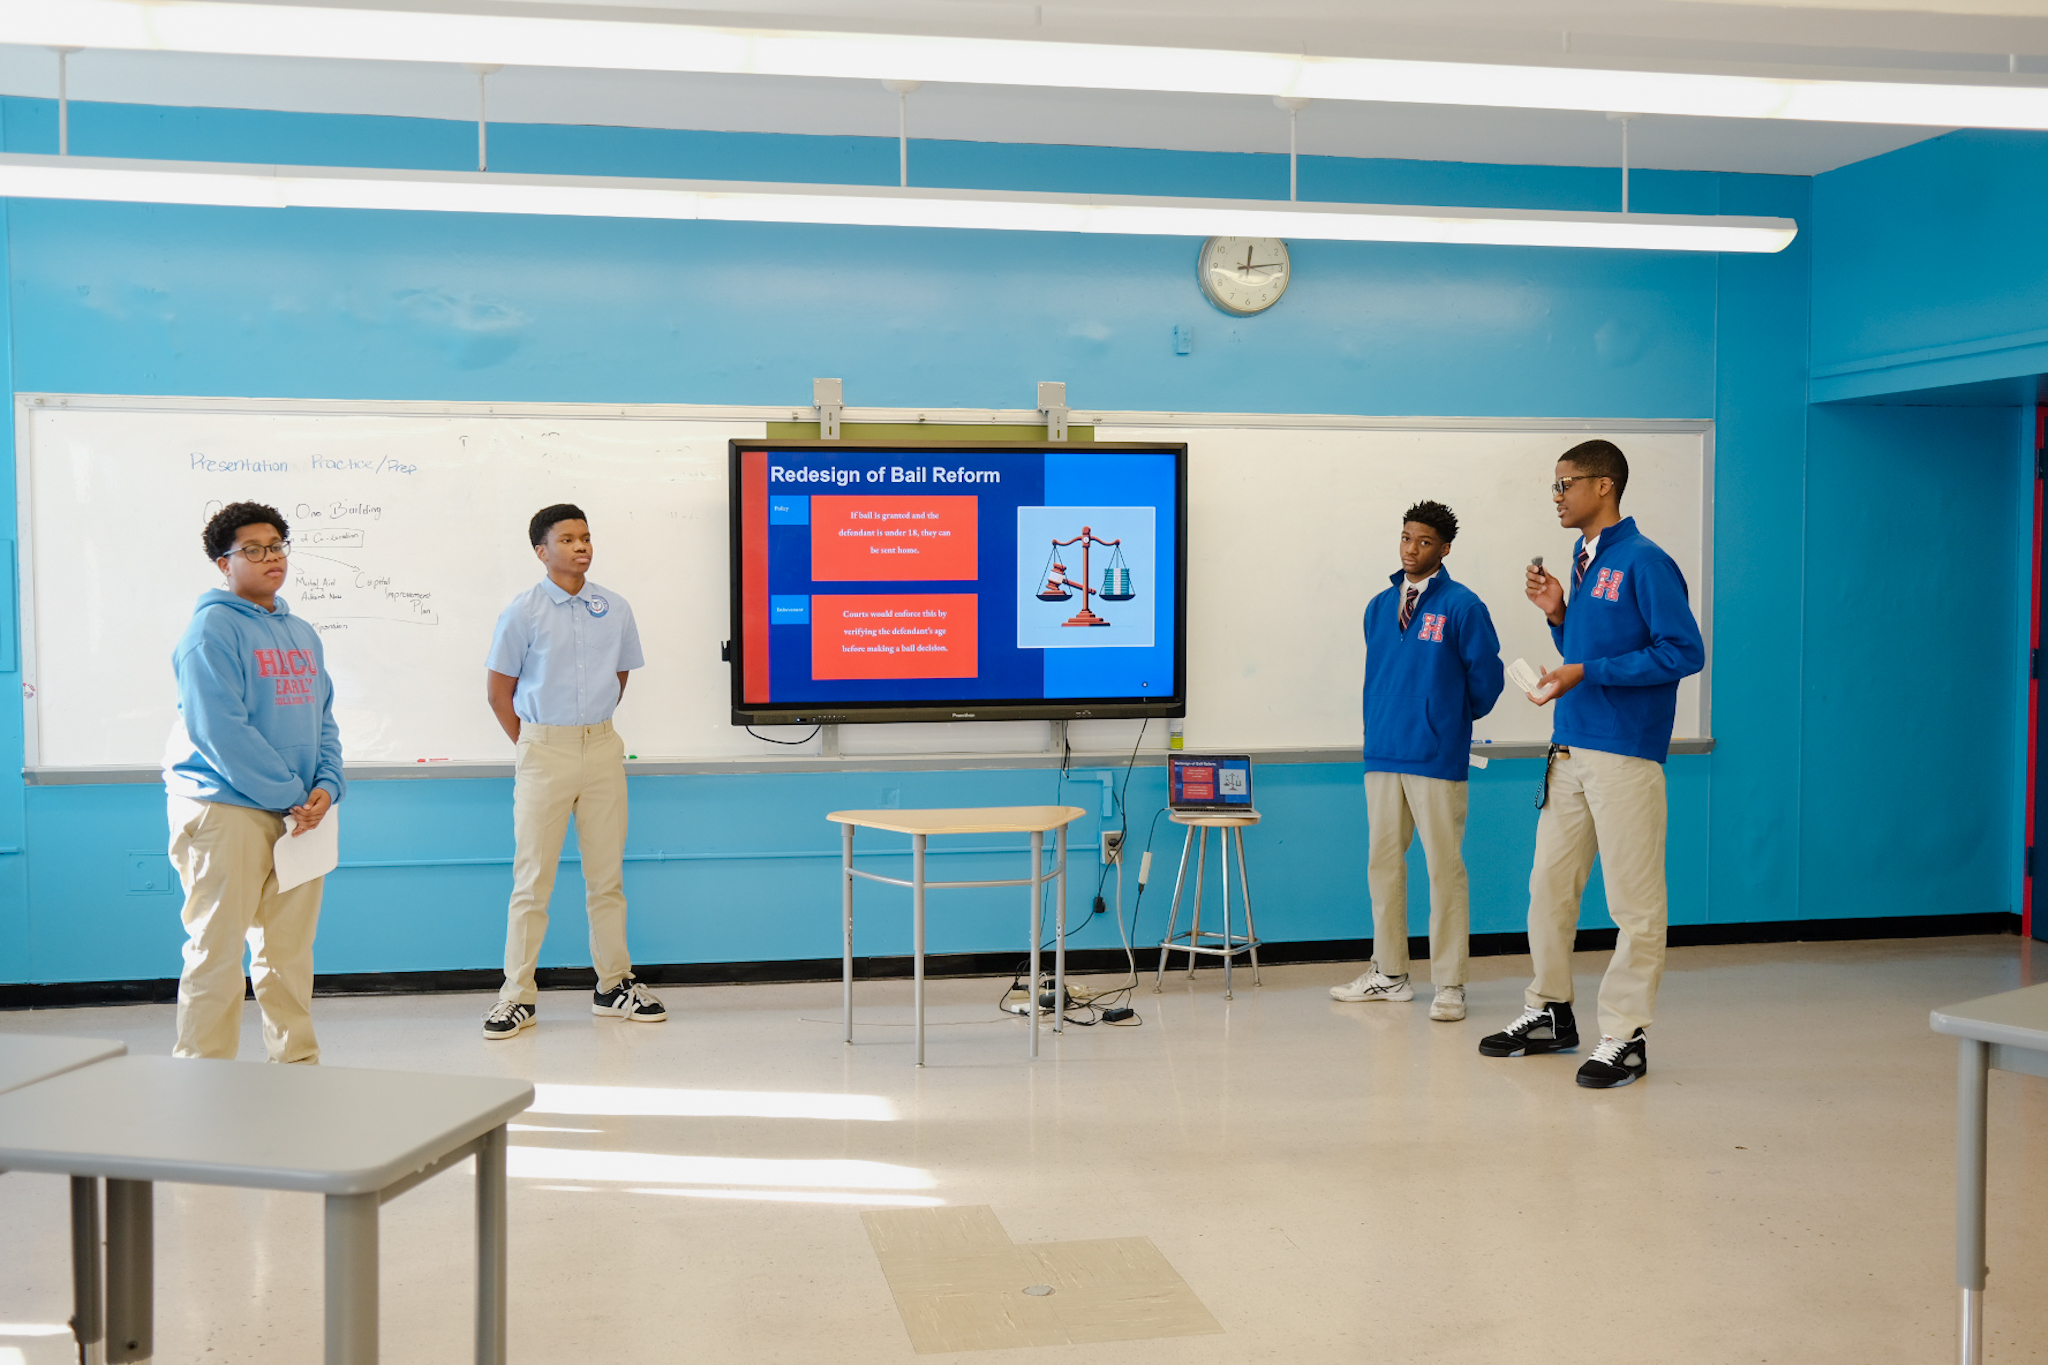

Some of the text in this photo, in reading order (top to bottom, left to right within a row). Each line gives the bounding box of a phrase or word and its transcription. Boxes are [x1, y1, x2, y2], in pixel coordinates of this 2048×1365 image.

[190, 452, 288, 472] Presentation
[770, 466, 1001, 486] Redesign of Bail Reform
[296, 502, 382, 520] One Building
[882, 512, 911, 521] granted
[908, 529, 920, 537] 18,
[921, 529, 937, 538] they
[355, 572, 390, 589] Capital
[1591, 567, 1624, 602] H
[410, 599, 430, 615] Plan
[938, 610, 948, 619] by
[844, 628, 877, 637] verifying
[1418, 613, 1447, 642] H
[867, 645, 895, 654] making
[276, 678, 313, 695] EARLY
